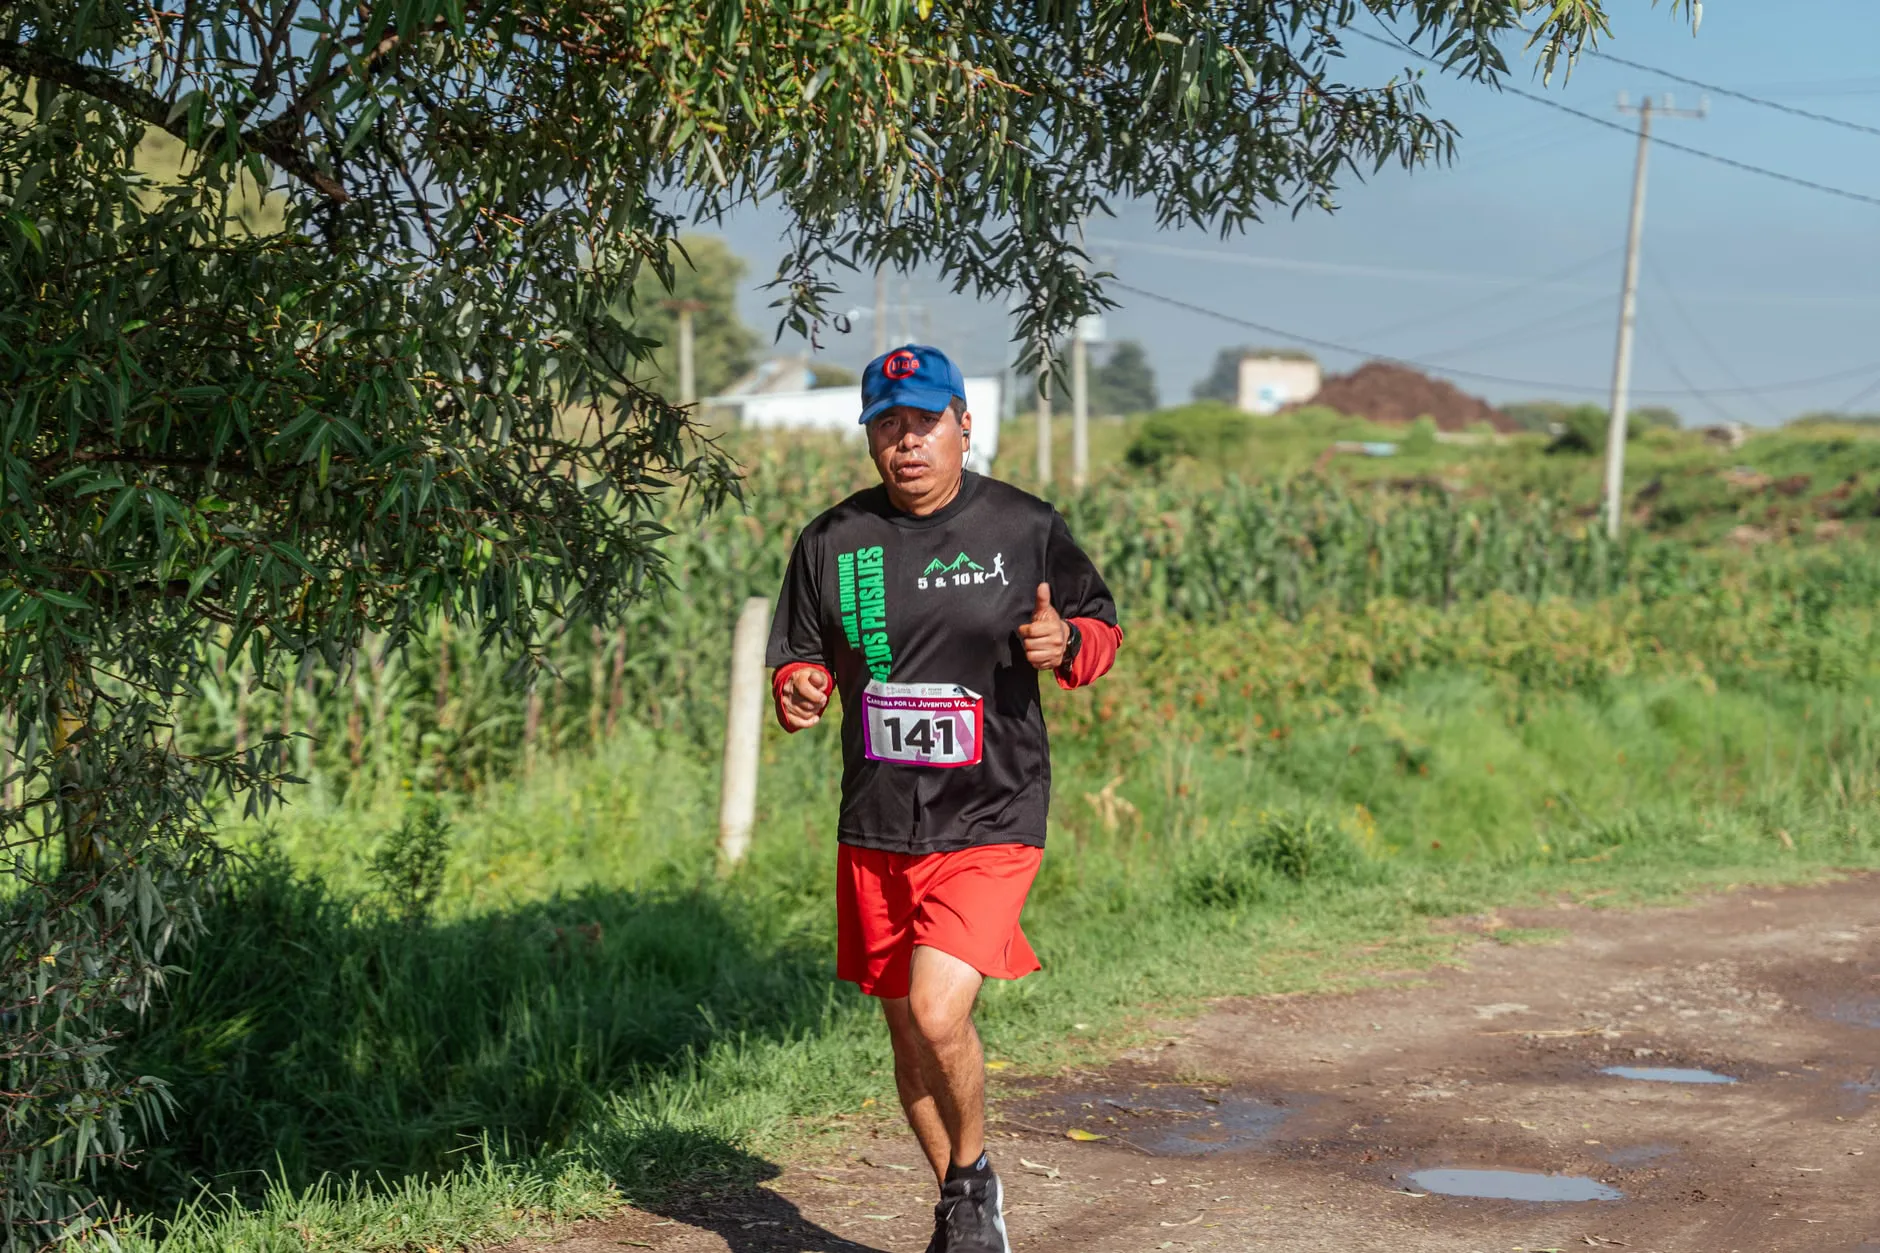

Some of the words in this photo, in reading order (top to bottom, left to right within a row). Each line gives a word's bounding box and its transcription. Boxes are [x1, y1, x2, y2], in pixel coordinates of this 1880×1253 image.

[838, 552, 856, 613] RUNNING
[857, 546, 886, 629] PAISAJES
[918, 577, 928, 590] 5
[935, 577, 947, 588] &
[952, 573, 971, 586] 10
[973, 572, 985, 584] K
[842, 612, 860, 649] TRAIL
[863, 631, 892, 665] LOS
[869, 664, 891, 683] DE
[918, 699, 952, 708] JUVENTUD
[884, 718, 953, 754] 141
